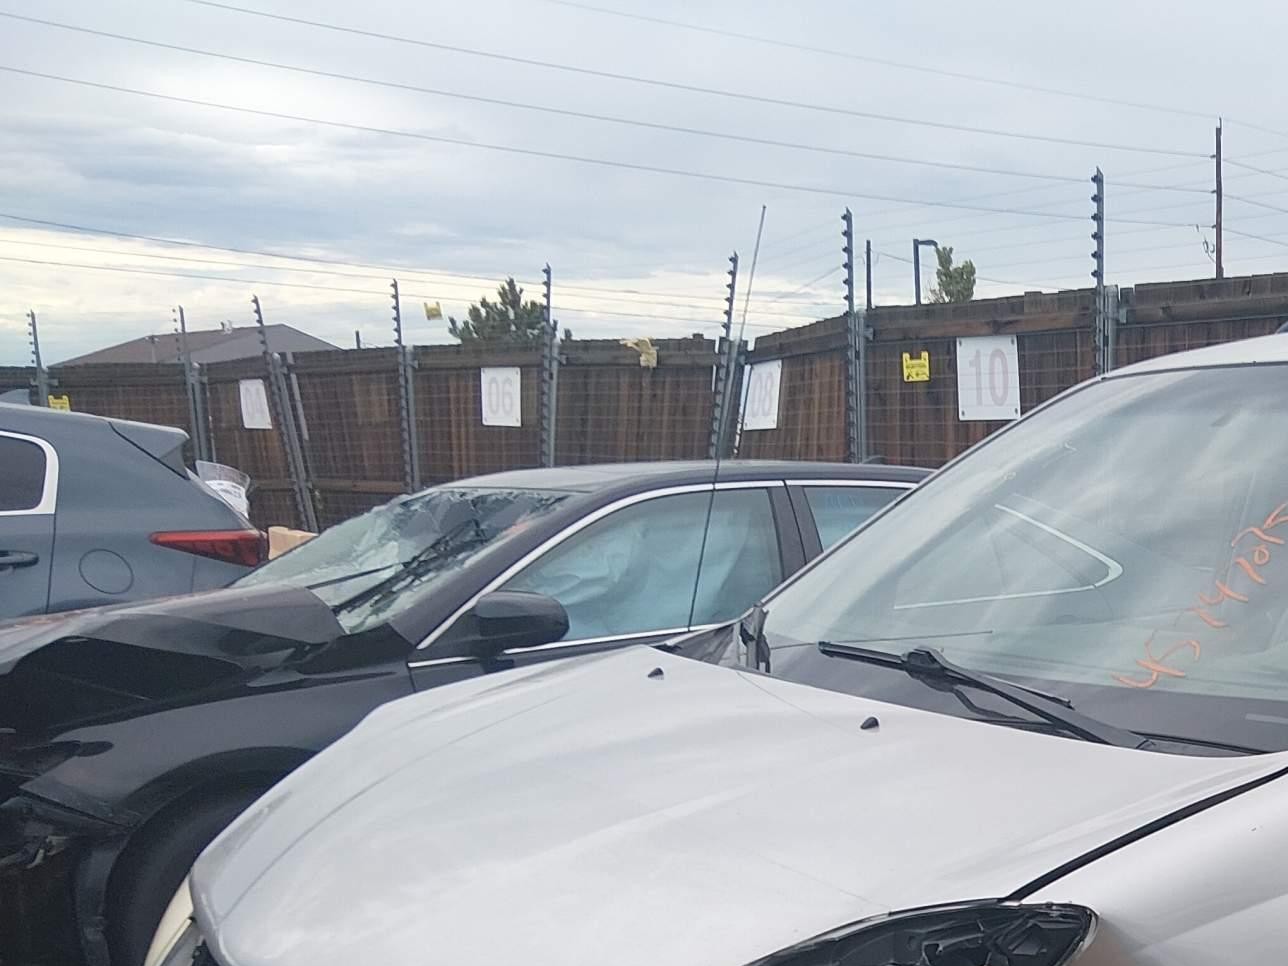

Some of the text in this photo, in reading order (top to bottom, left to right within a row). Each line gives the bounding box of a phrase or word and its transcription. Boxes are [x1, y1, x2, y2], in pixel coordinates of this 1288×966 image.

[488, 376, 513, 416] 06
[750, 371, 775, 418] 08
[968, 347, 1009, 407] 10
